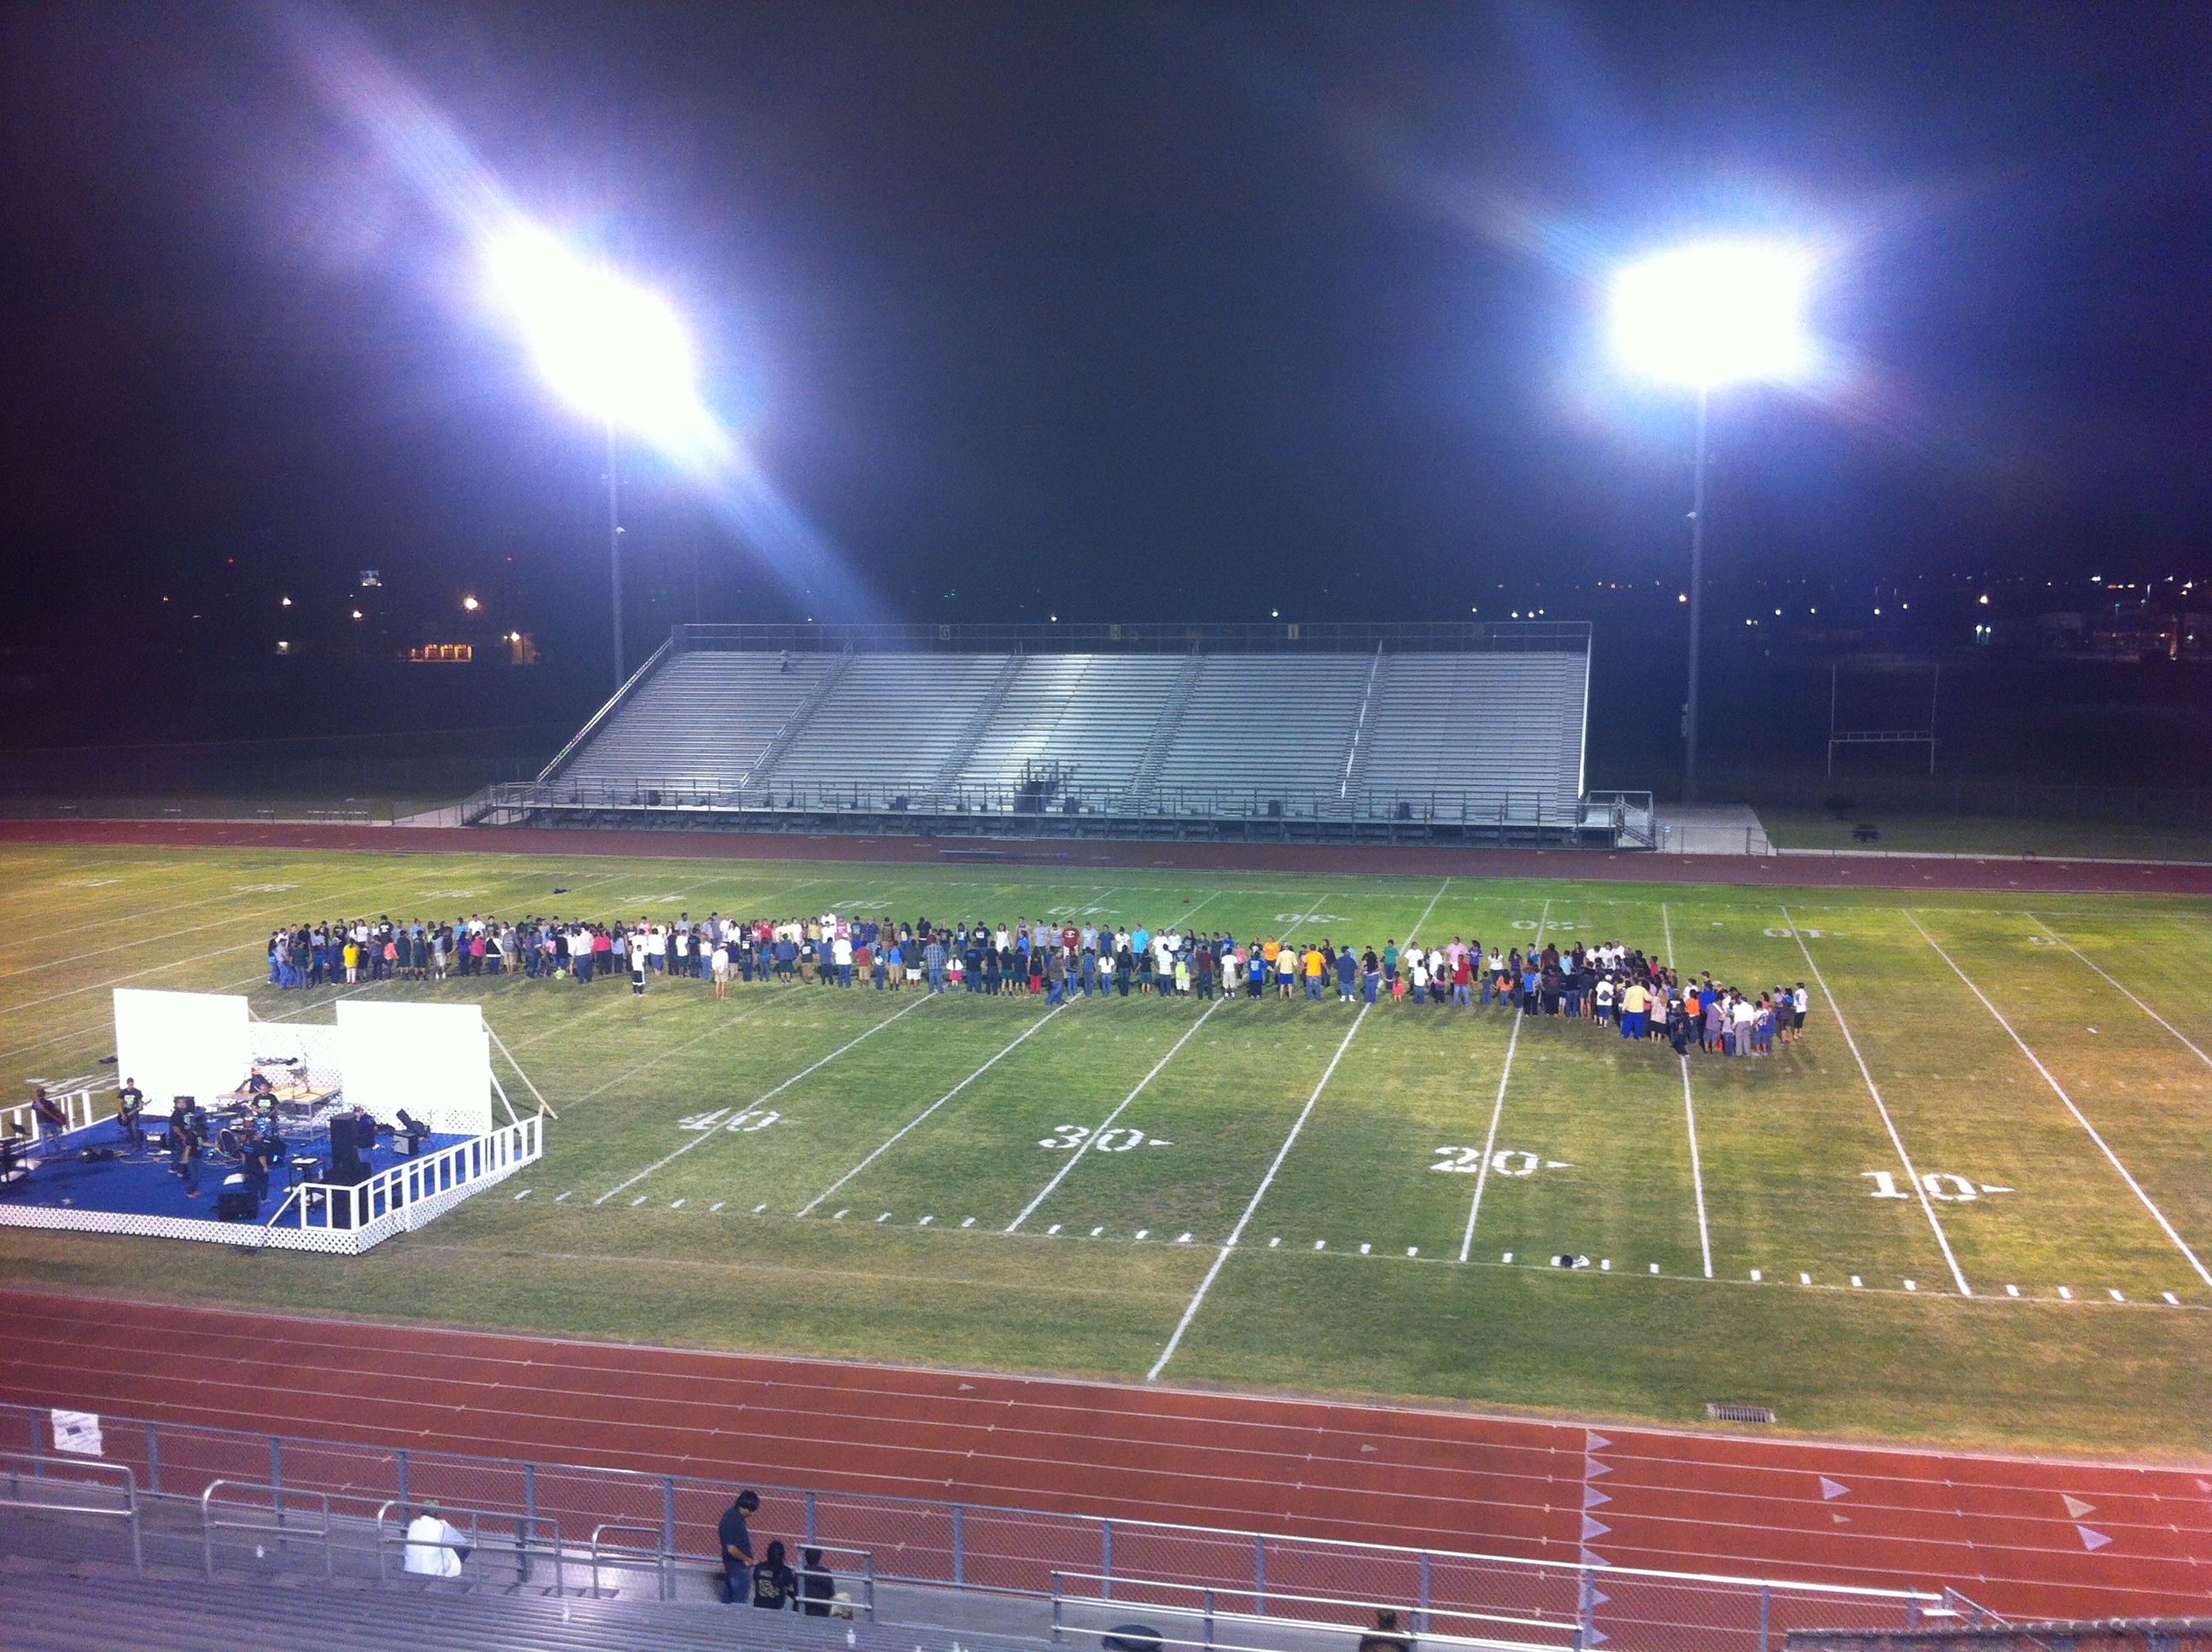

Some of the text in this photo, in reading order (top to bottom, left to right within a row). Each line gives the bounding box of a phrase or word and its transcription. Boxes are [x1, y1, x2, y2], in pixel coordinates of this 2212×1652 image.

[677, 1108, 781, 1131] 40
[1038, 1125, 1144, 1151] 30
[1430, 1147, 1539, 1176] 20
[1861, 1172, 1977, 1201] 10
